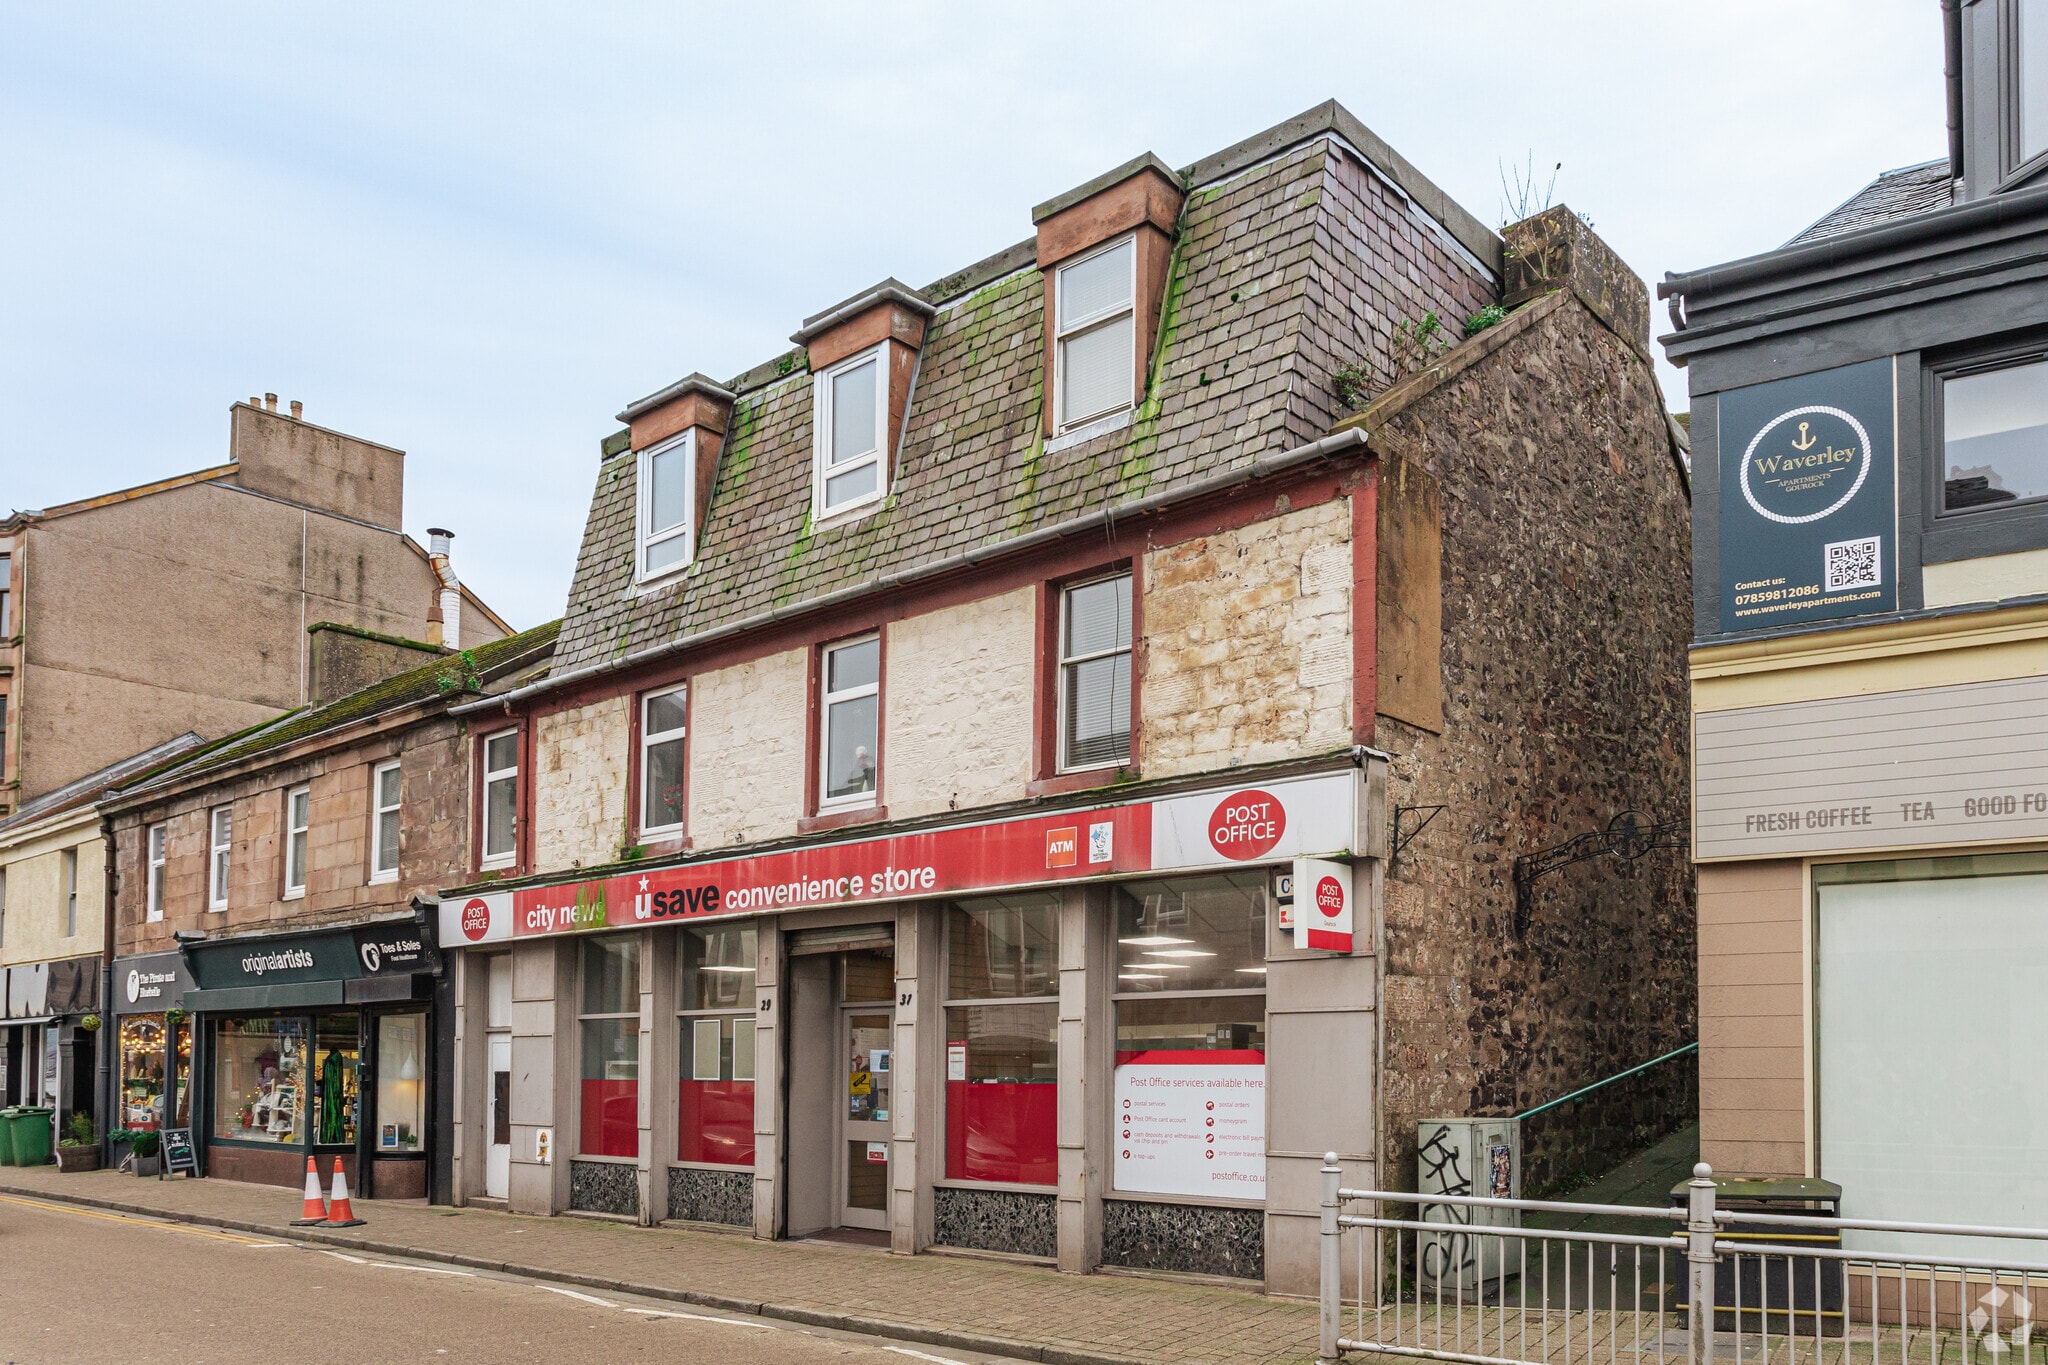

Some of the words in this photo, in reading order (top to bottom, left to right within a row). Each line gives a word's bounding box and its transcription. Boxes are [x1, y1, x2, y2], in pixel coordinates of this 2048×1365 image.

[1755, 446, 1856, 475] Waverley
[1778, 473, 1832, 488] APARTMENTS
[1785, 481, 1825, 493] GOUROCK
[1735, 580, 1771, 591] Contact
[1772, 577, 1786, 586] us:
[1735, 584, 1820, 606] 07859812086
[1735, 590, 1881, 617] www.waverleyapartments.com
[1226, 803, 1270, 824] POST
[1745, 811, 1800, 834] FRESH
[1806, 806, 1872, 829] COFFEE
[1900, 801, 1935, 822] TEA
[1964, 795, 2016, 818] GOOD
[1215, 821, 1275, 844] OFFICE
[1049, 840, 1073, 854] ATM
[1322, 884, 1338, 896] POST
[527, 904, 555, 931] city
[725, 875, 864, 909] convenience
[870, 866, 936, 894] store
[1318, 895, 1341, 908] OFFICE
[467, 906, 484, 919] POST
[464, 918, 487, 931] OFFICE
[379, 943, 396, 953] Toes
[396, 941, 402, 952] &
[402, 940, 421, 951] Soles
[242, 949, 314, 976] originalartists
[761, 999, 771, 1011] 29
[900, 994, 912, 1006] 31
[1130, 1077, 1147, 1087] Post
[1149, 1077, 1171, 1087] Office
[1173, 1078, 1205, 1088] services
[1207, 1078, 1242, 1088] available
[1244, 1078, 1266, 1088] here.
